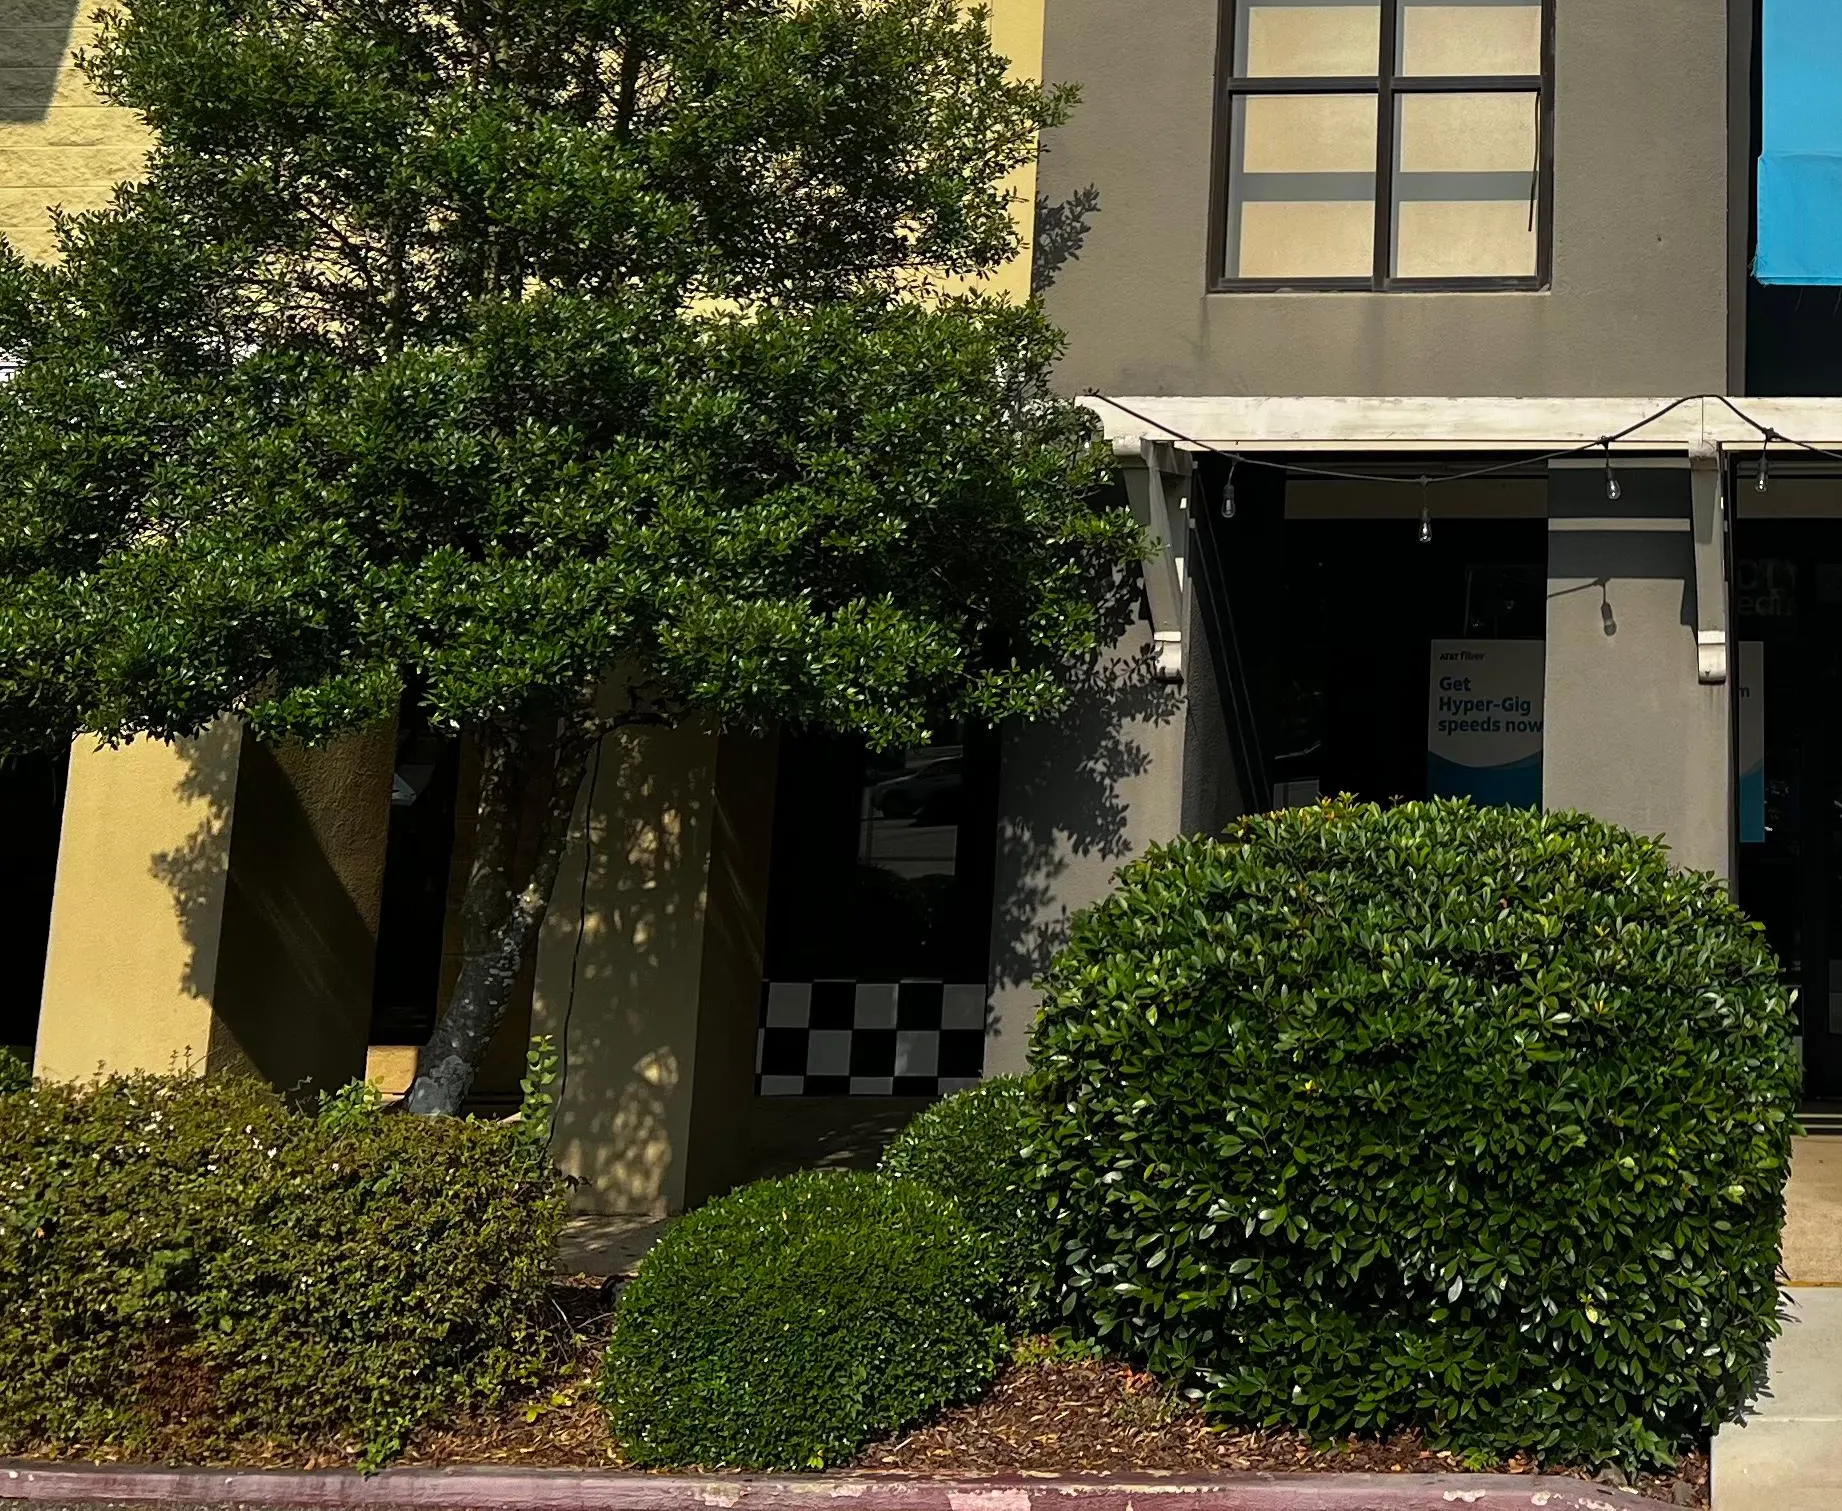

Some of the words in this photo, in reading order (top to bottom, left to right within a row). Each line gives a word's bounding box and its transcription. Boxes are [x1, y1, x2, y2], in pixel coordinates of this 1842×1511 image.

[1439, 676, 1472, 692] Get
[1438, 696, 1532, 717] Hyper-Gig
[1437, 716, 1501, 736] speeds
[1505, 719, 1544, 733] now
